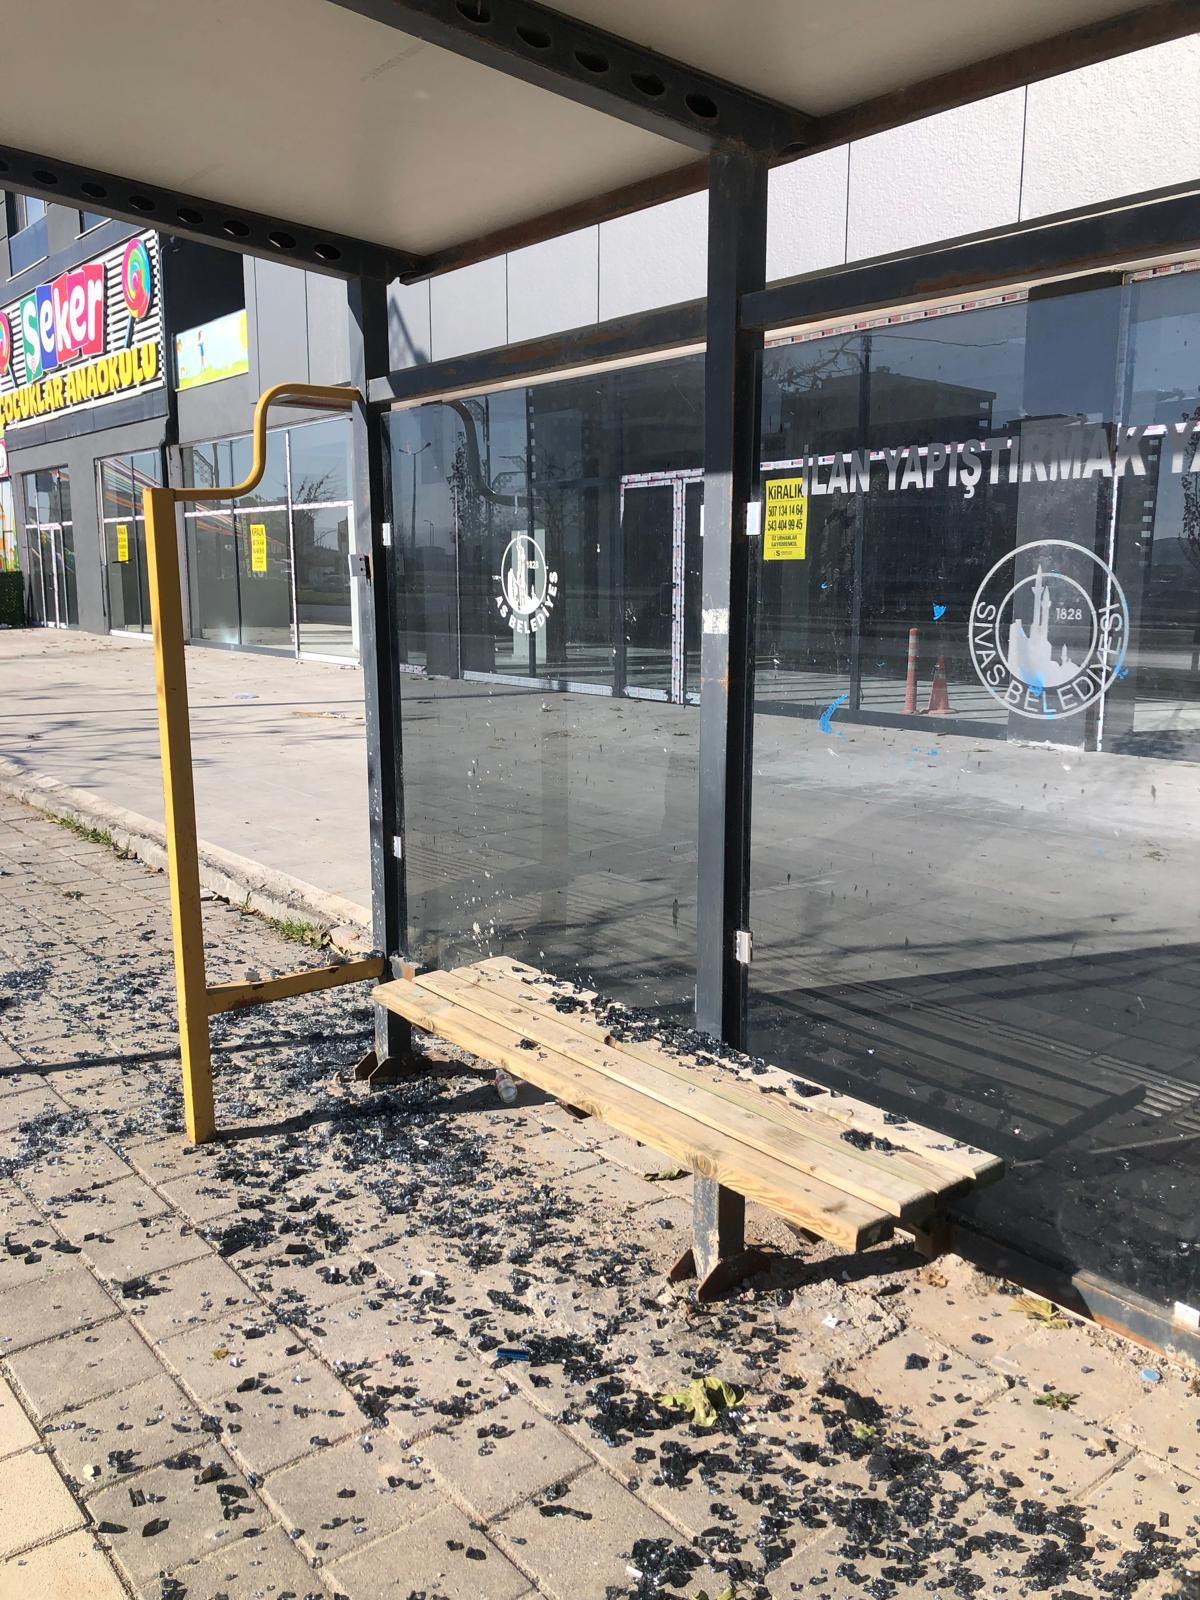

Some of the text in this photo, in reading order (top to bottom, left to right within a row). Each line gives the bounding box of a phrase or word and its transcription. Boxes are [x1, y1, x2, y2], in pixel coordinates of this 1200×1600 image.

[65, 342, 158, 405] ANAOKULU
[882, 425, 1150, 499] YAPIŞTIRMAK
[778, 505, 788, 516] 134
[1055, 607, 1083, 621] 1828
